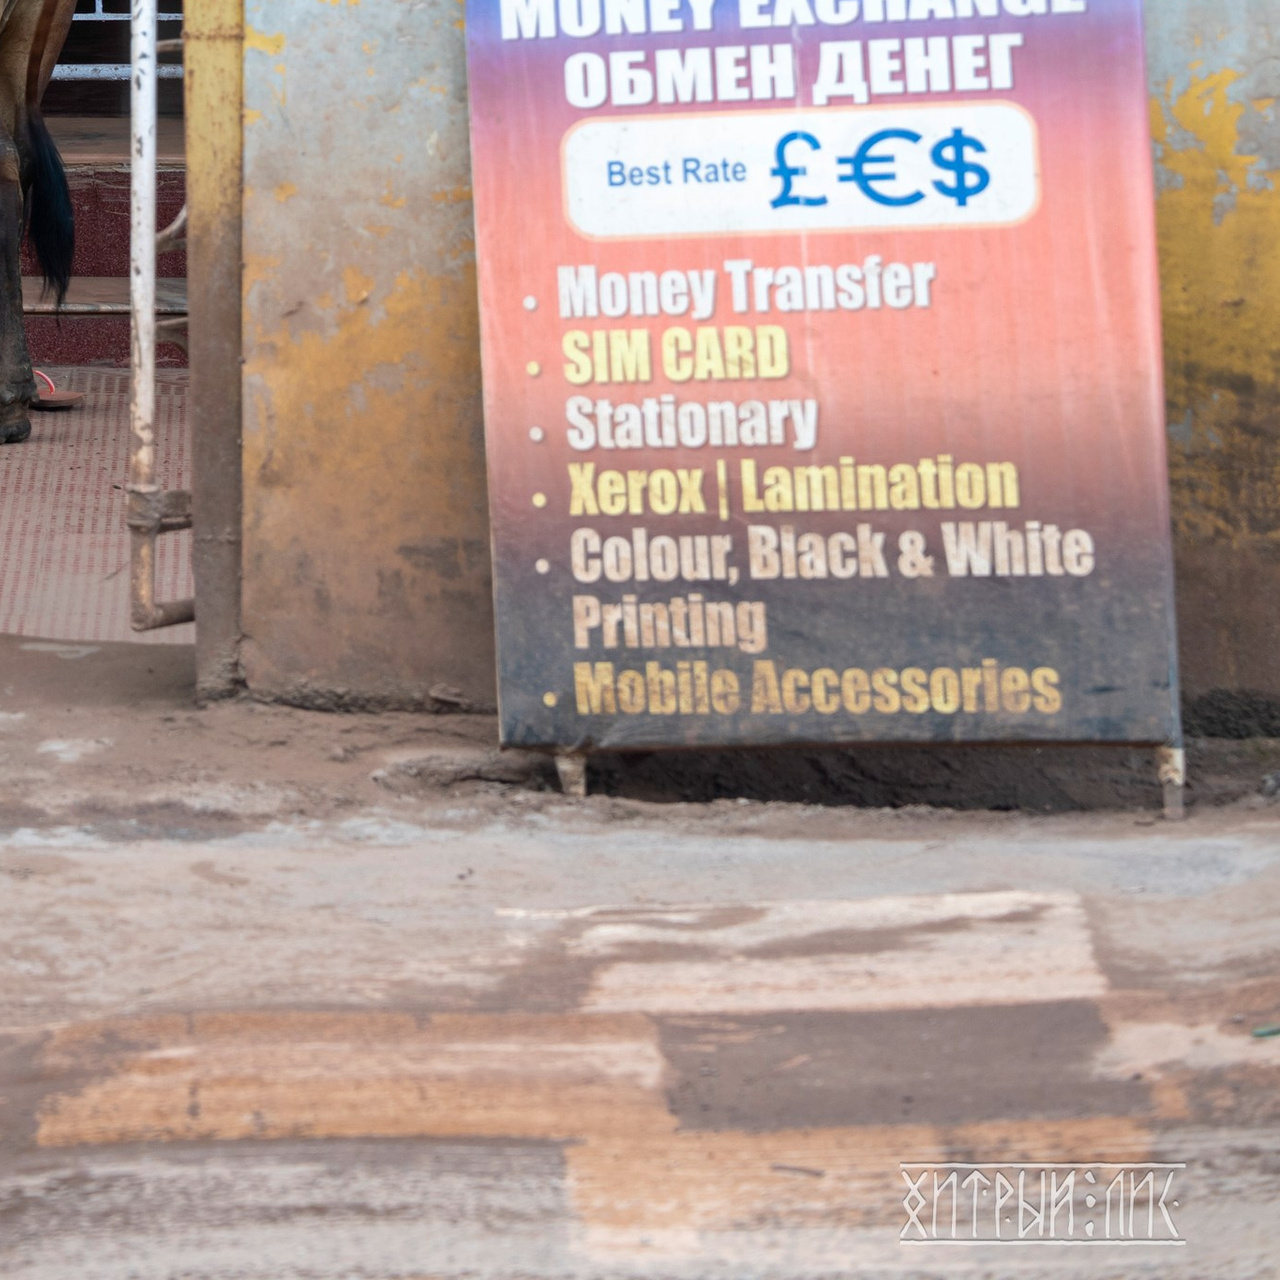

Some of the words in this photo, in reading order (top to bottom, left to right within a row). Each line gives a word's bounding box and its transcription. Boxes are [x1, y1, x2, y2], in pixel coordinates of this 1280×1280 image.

[563, 43, 795, 109] ОБМЕН
[812, 33, 1024, 105] ДЕНЕГ
[606, 159, 672, 188] Best
[681, 157, 748, 185] Rate
[556, 265, 716, 320] Money
[723, 256, 935, 315] Transfer
[561, 328, 651, 385] SIM
[661, 324, 791, 382] CARD
[565, 394, 819, 451] Stationary
[568, 461, 706, 517] Xerox
[740, 454, 1020, 513] Lamination
[570, 526, 738, 586] Colour,
[747, 521, 889, 581] Black
[897, 525, 935, 578] &
[940, 519, 1096, 579] White
[572, 593, 768, 655] Printing
[573, 659, 739, 715] Mobile
[750, 657, 1064, 715] Accessories
